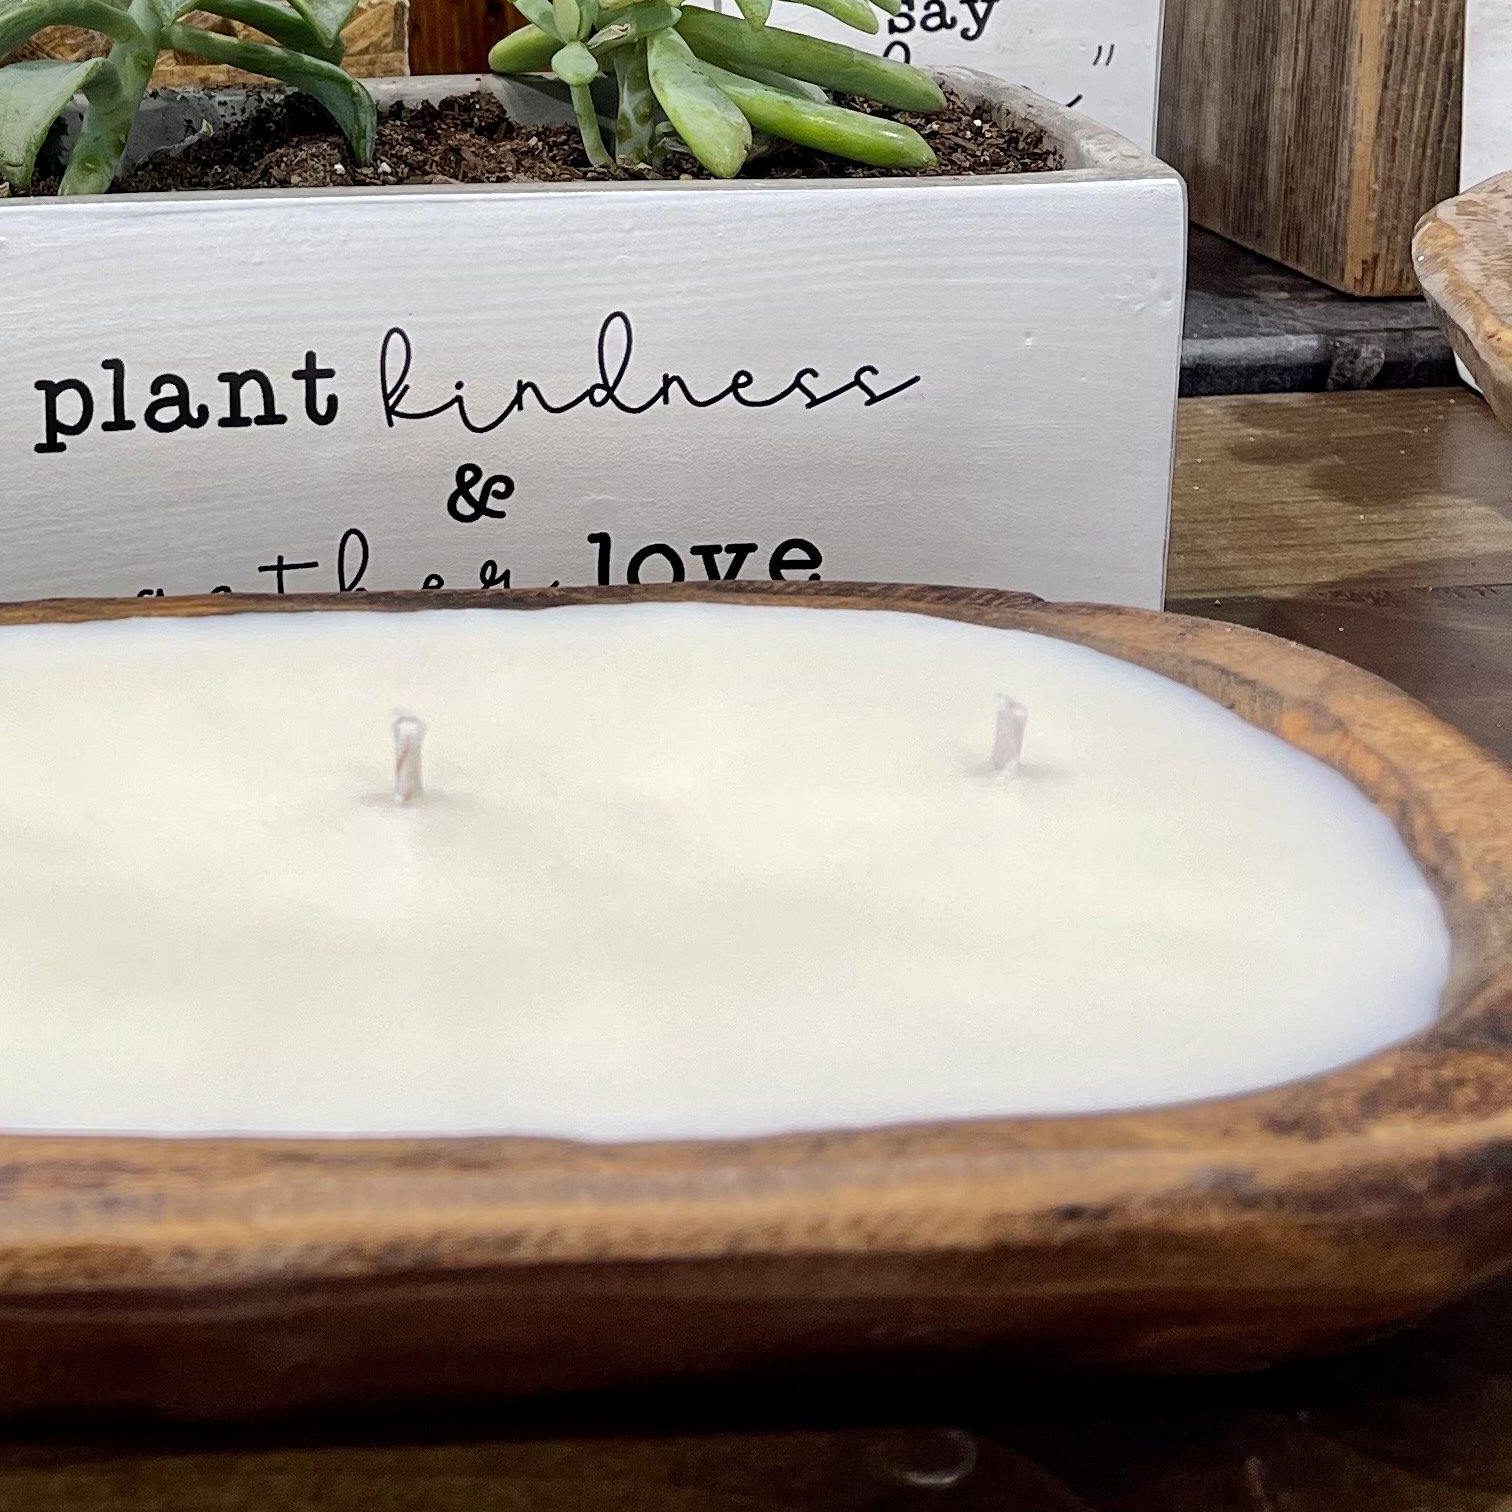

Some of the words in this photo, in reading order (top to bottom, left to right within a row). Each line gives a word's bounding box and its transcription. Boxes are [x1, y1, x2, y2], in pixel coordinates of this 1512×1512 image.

[33, 350, 339, 454] plant
[380, 311, 921, 434] kindness
[446, 462, 515, 524] &
[586, 531, 823, 586] love
